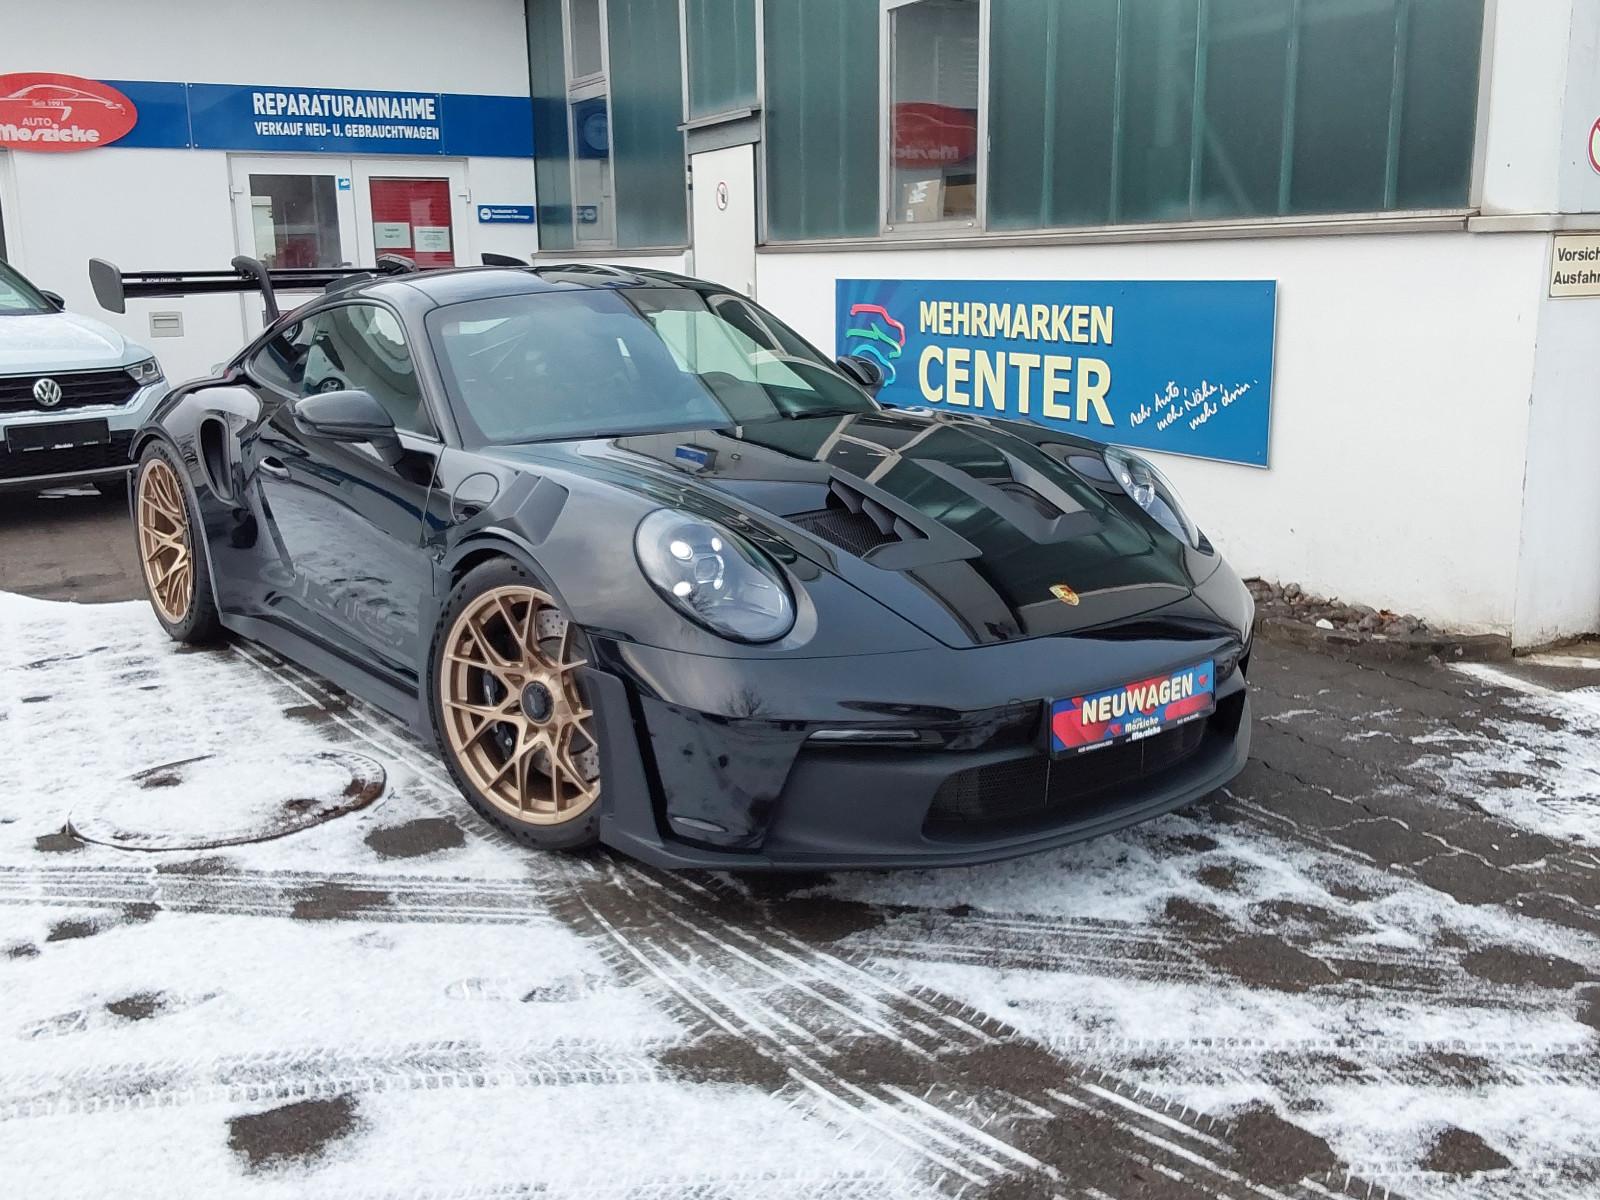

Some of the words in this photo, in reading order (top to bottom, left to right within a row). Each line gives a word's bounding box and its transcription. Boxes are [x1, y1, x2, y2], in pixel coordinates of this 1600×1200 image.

[22, 118, 52, 126] AUTO
[253, 92, 436, 120] REPARATURANNAHME
[254, 121, 303, 136] VERKAUF
[305, 122, 331, 137] NEU-
[333, 123, 343, 137] U.
[345, 124, 440, 141] GEBRAUCHTWAGEN
[919, 300, 1114, 345] MEHRMARKEN
[918, 345, 1115, 426] CENTER
[1082, 672, 1193, 725] NEUWAGEN
